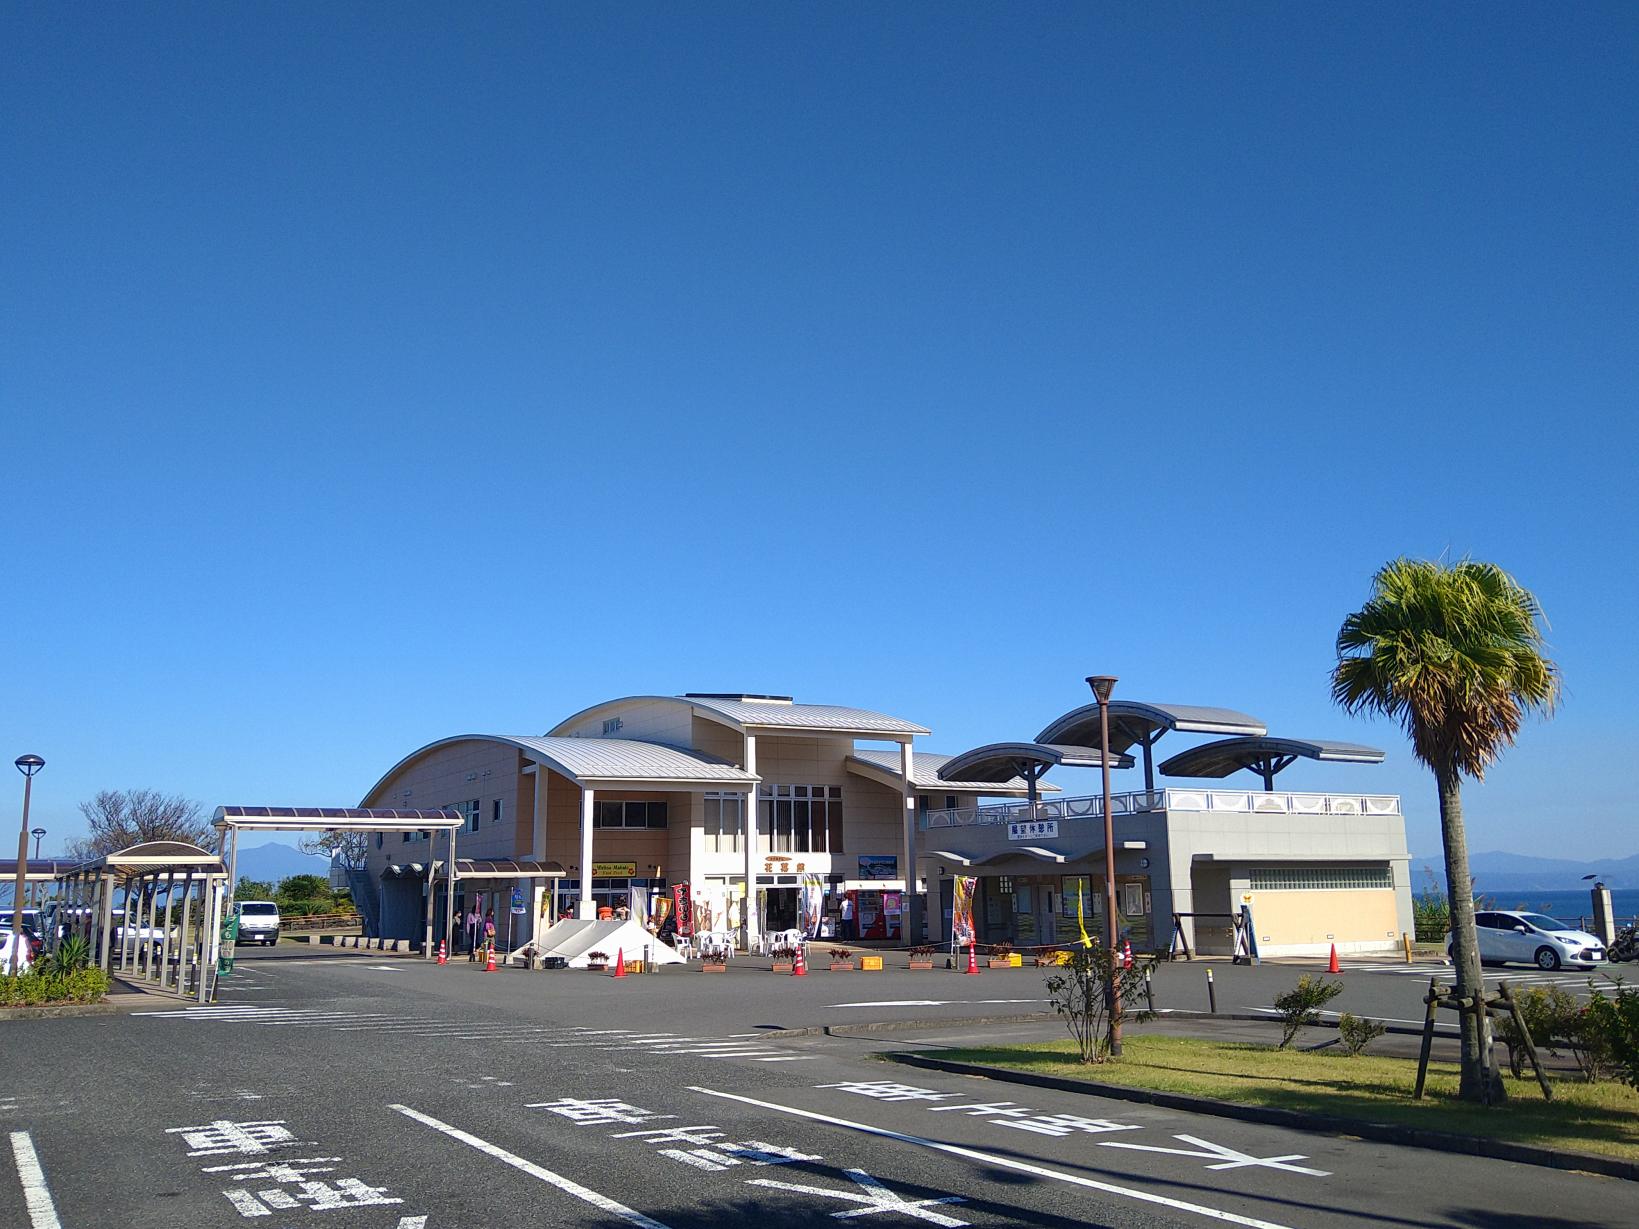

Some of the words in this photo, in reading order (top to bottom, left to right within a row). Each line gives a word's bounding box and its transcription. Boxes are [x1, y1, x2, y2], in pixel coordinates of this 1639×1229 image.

[1011, 822, 1054, 835] 展望休憩所
